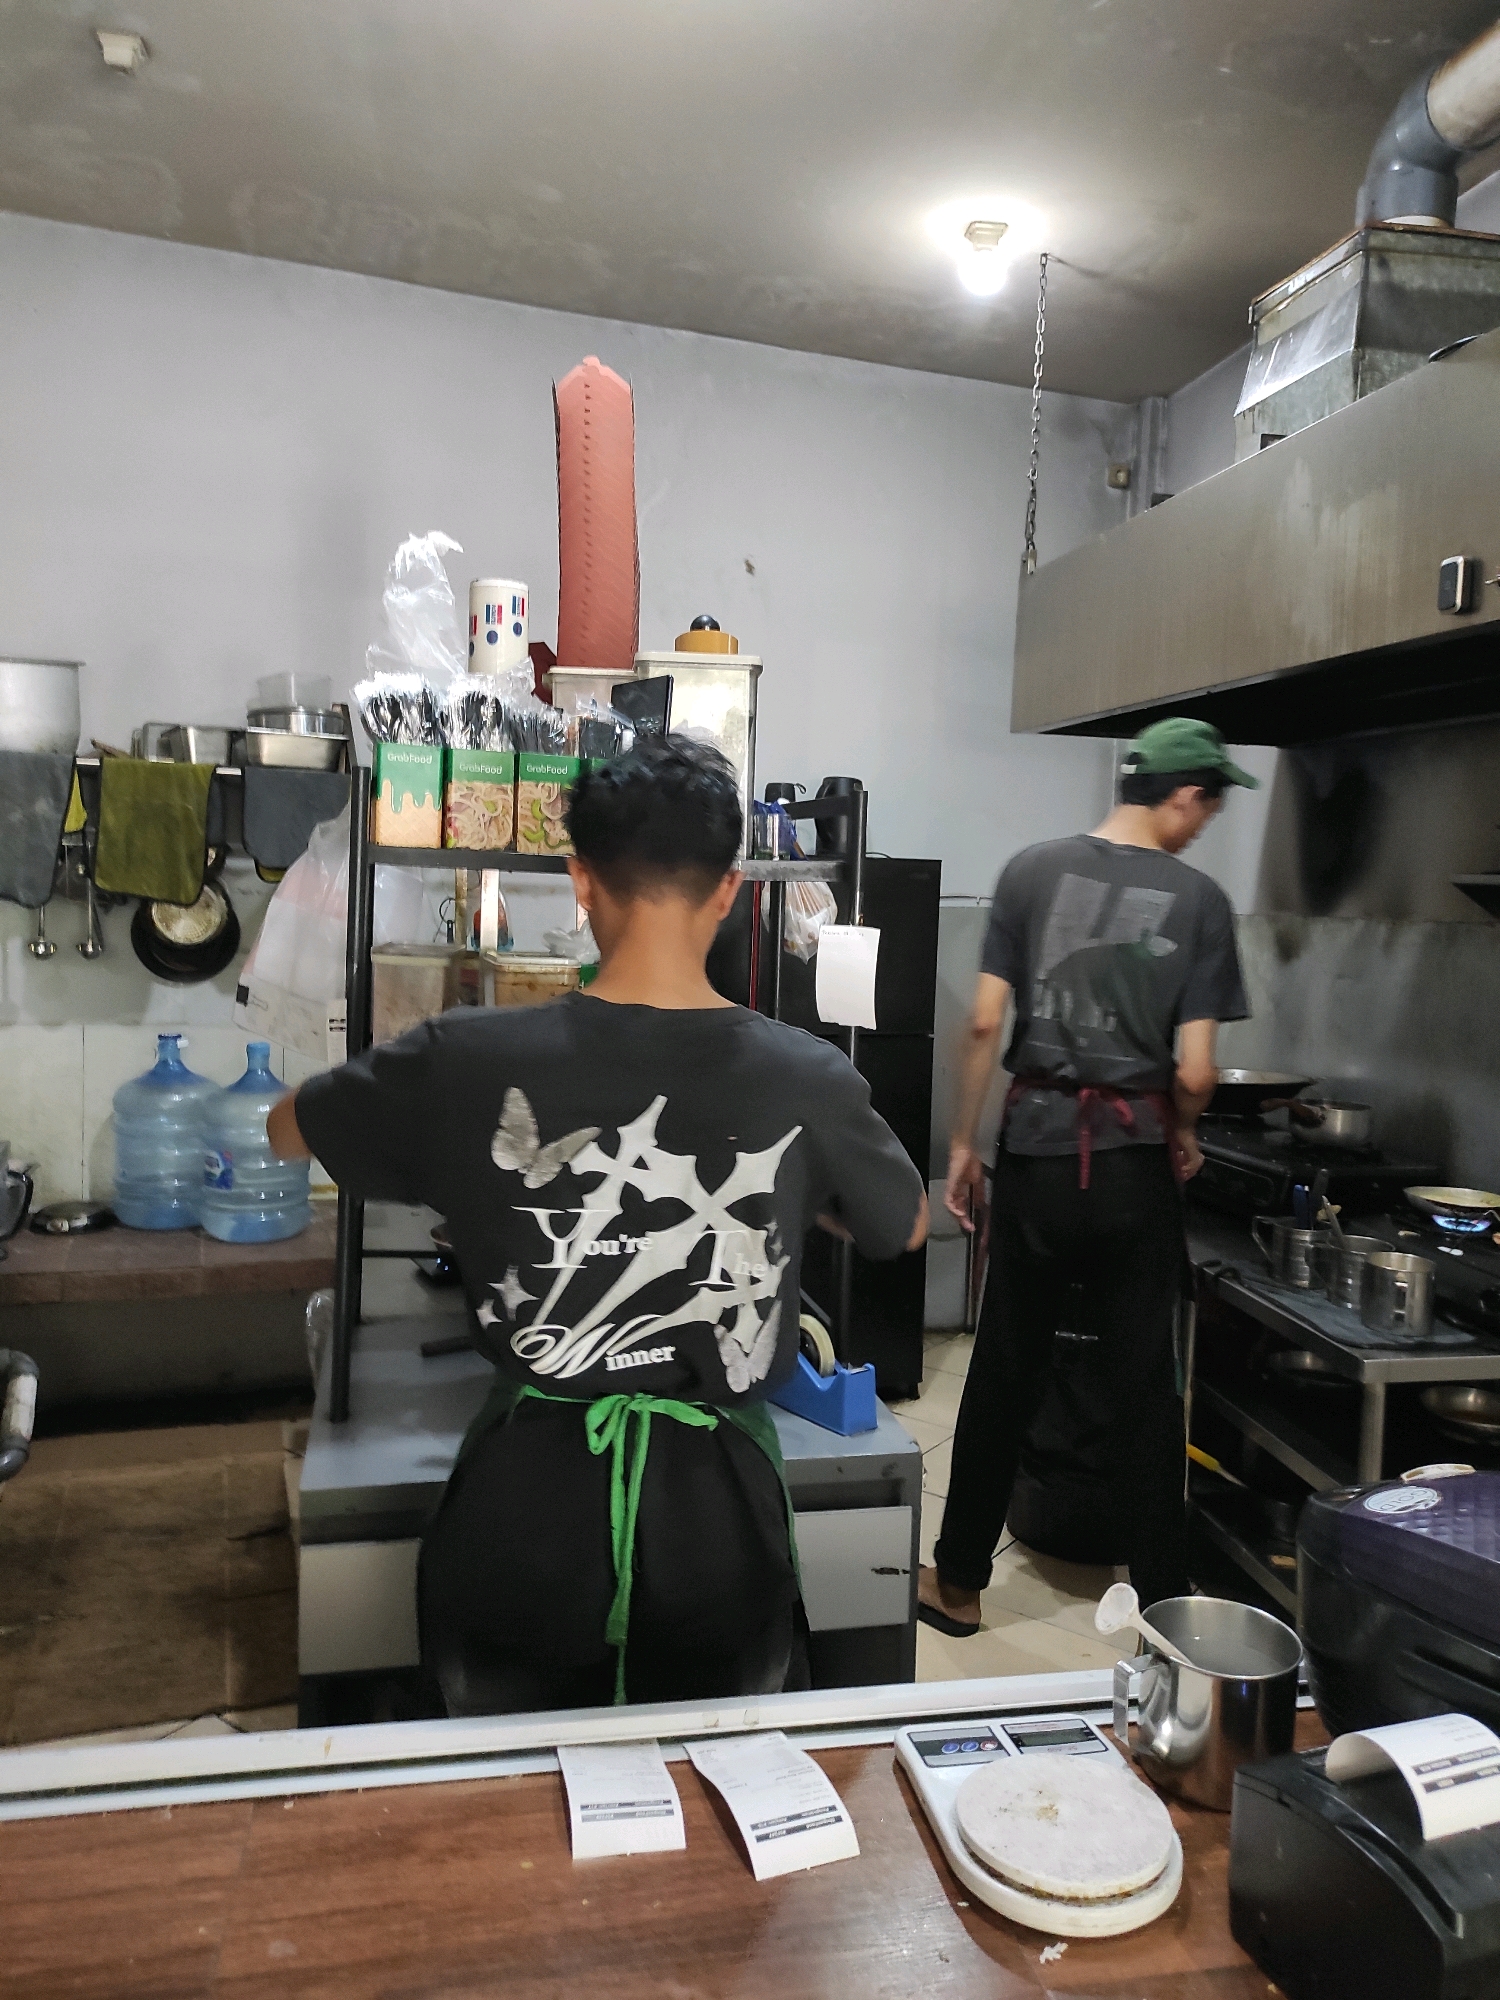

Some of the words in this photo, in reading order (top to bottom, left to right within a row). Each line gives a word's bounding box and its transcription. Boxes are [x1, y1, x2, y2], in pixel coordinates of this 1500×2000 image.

[387, 752, 433, 765] GrabFood
[459, 762, 503, 775] GrabFood
[526, 762, 568, 775] GrabFood
[511, 1205, 654, 1269] You're
[689, 1230, 768, 1286] The
[510, 1314, 677, 1379] Winner
